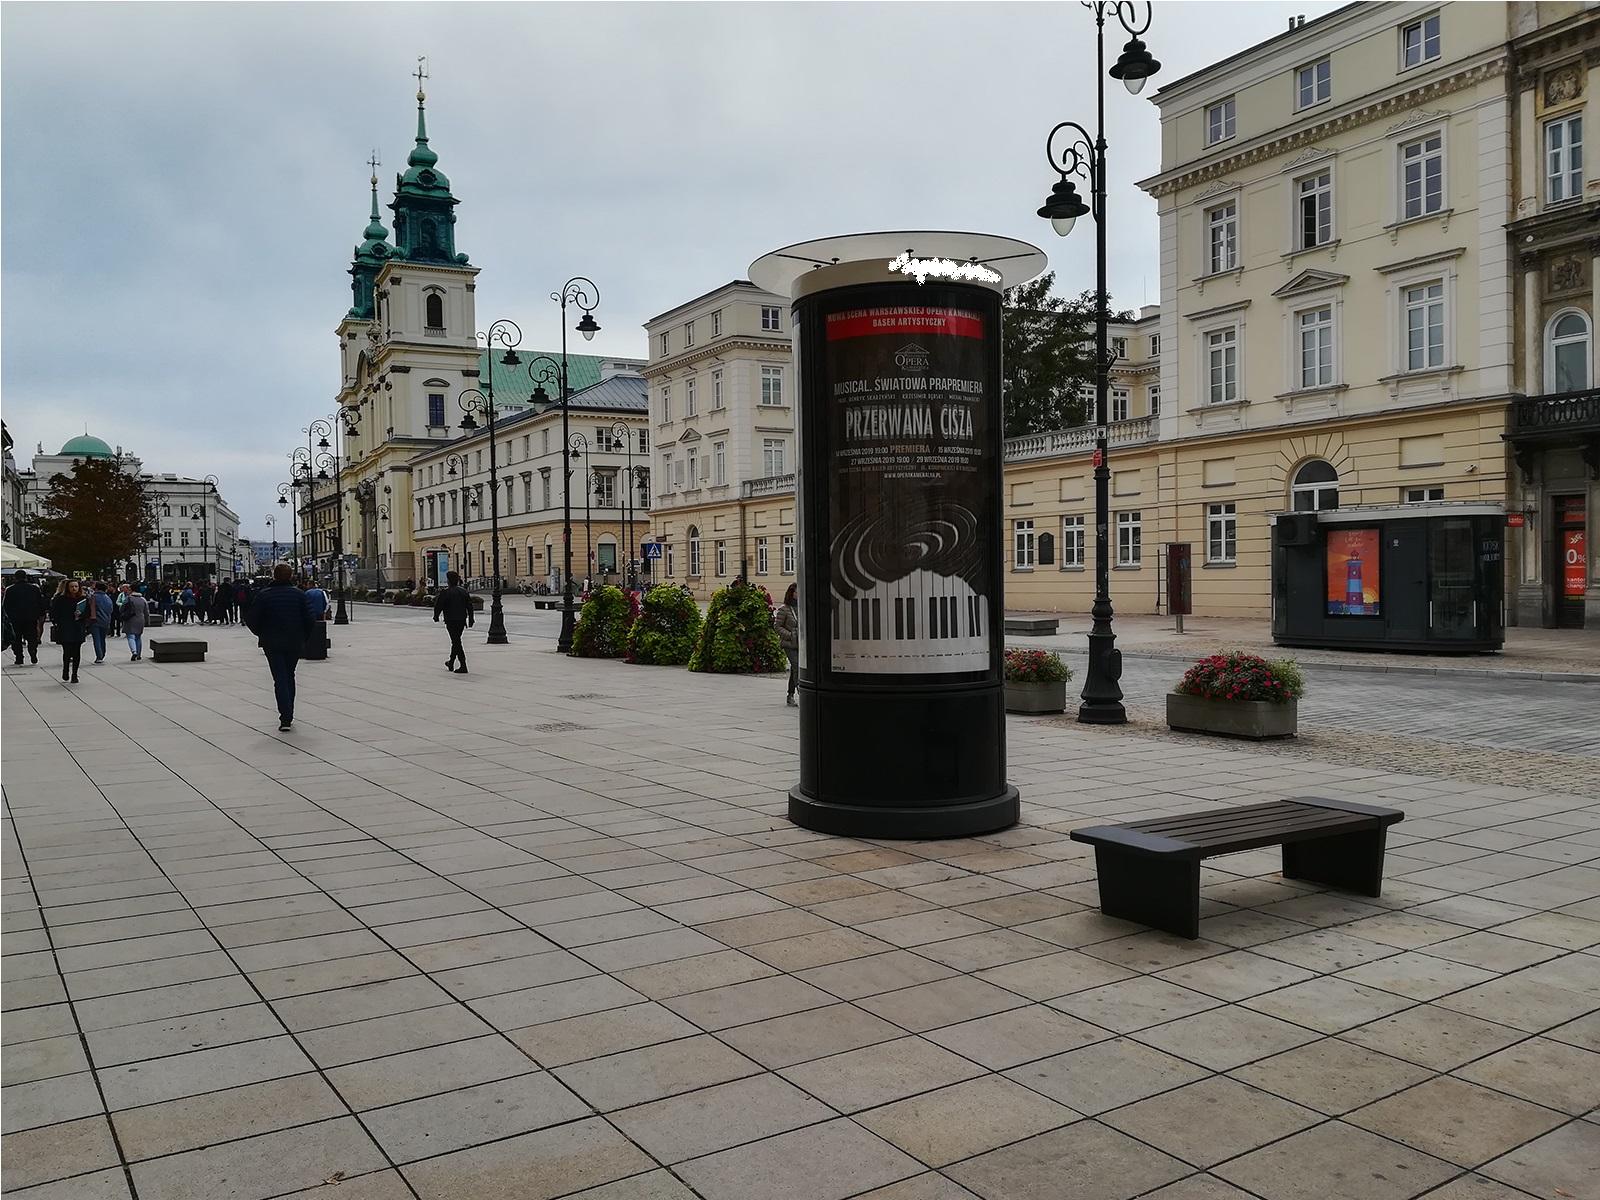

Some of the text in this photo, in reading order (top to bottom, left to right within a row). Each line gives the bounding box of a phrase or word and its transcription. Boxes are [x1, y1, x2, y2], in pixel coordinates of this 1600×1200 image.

[847, 309, 867, 319] SCENA
[869, 306, 925, 316] WARSZAWSKIEJ
[872, 317, 946, 327] BASEN ARTYSTYCZNY
[834, 376, 983, 395] MUSICAL. ŚWIATOWA PRAPREMIERA
[846, 406, 934, 439] PRZERWANA
[889, 444, 930, 454] PREMIERA
[882, 456, 895, 464] 2019
[924, 455, 947, 463] WRZEŚNIA
